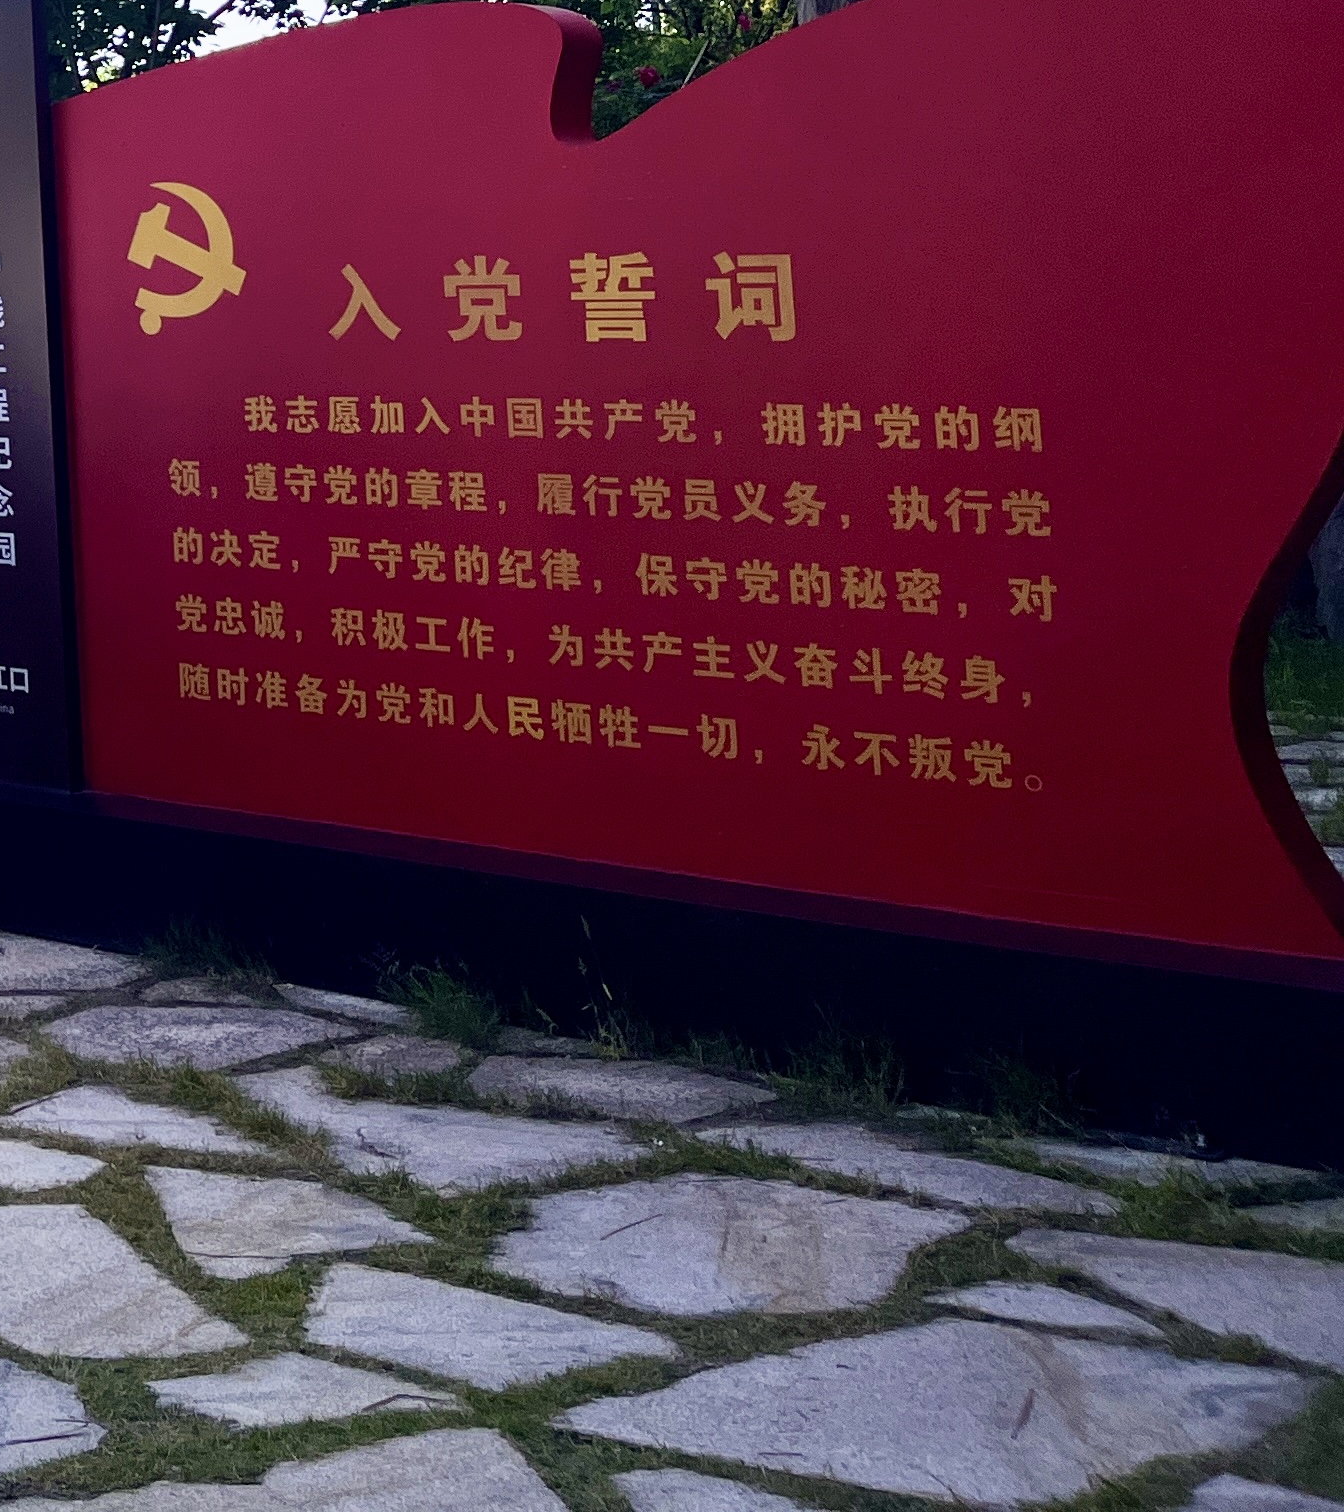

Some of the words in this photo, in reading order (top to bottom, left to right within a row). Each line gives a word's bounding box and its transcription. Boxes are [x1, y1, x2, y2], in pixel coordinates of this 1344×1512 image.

[328, 251, 797, 343] 入党誓词
[244, 394, 1043, 453] 我志愿加入中国共产党，拥护党的纲
[178, 662, 1042, 792] 随时准备为党和人民牺牲一切，永不叛党。
